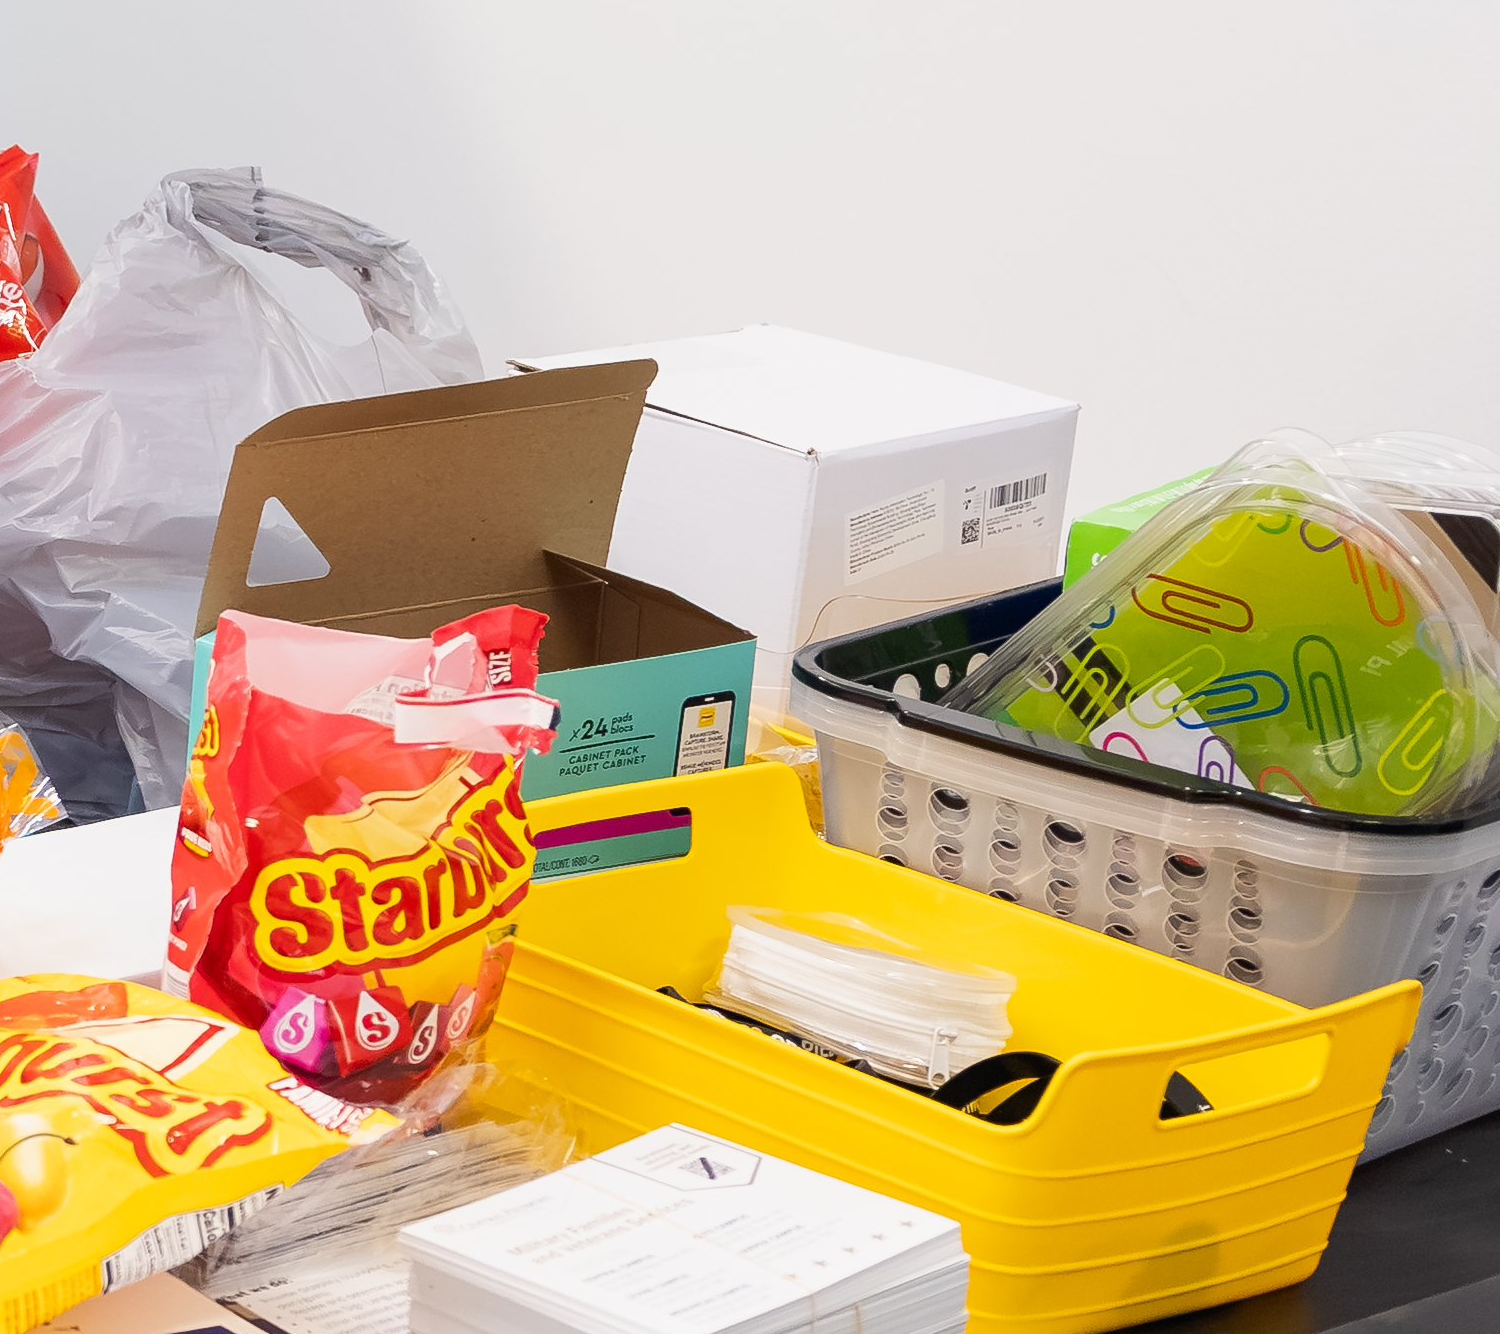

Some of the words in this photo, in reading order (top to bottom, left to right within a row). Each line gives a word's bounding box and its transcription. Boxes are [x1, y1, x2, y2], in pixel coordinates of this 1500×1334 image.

[612, 713, 632, 725] pads
[611, 724, 633, 735] blocs
[569, 750, 611, 765] CABINET
[614, 746, 639, 757] PACK
[559, 762, 600, 776] PAQUET
[602, 755, 647, 770] CABINET
